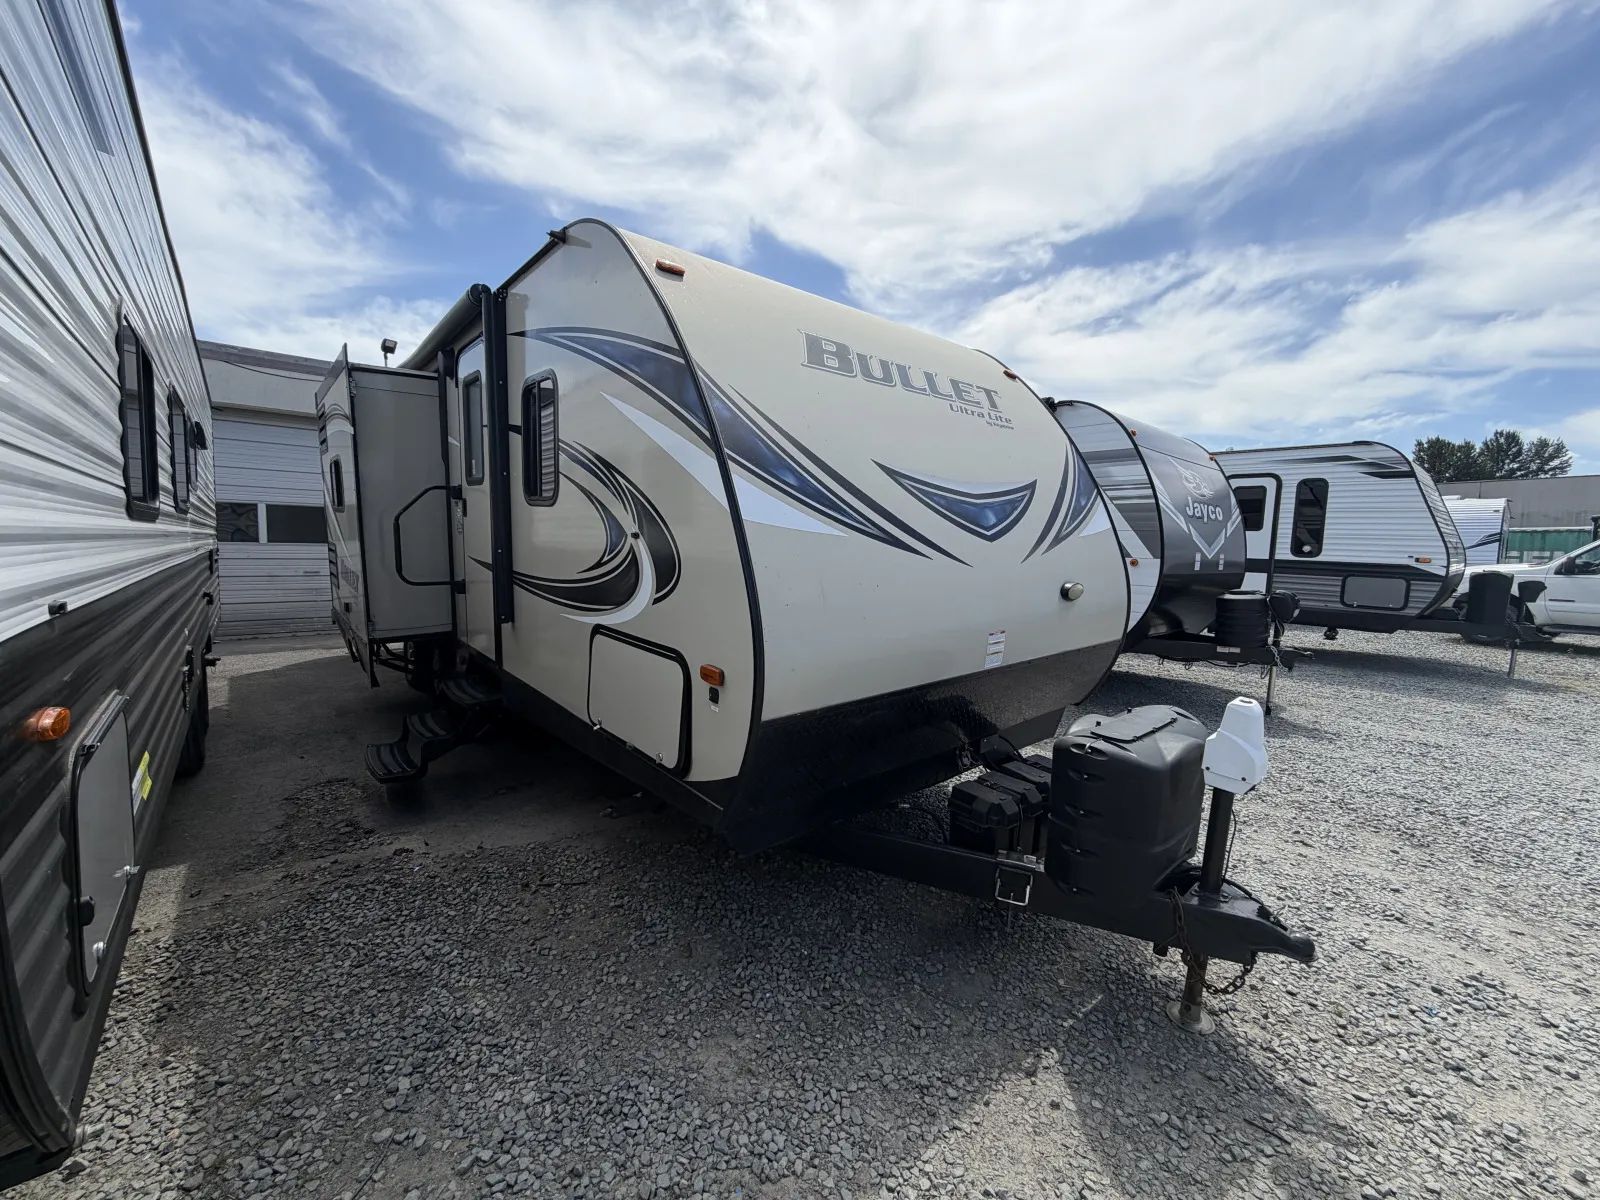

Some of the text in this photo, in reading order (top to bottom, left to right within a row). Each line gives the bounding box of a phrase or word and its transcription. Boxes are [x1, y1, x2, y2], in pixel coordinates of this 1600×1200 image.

[798, 329, 1003, 413] BULLET
[949, 403, 1012, 424] Ultra Lite
[1186, 496, 1223, 523] Jayco
